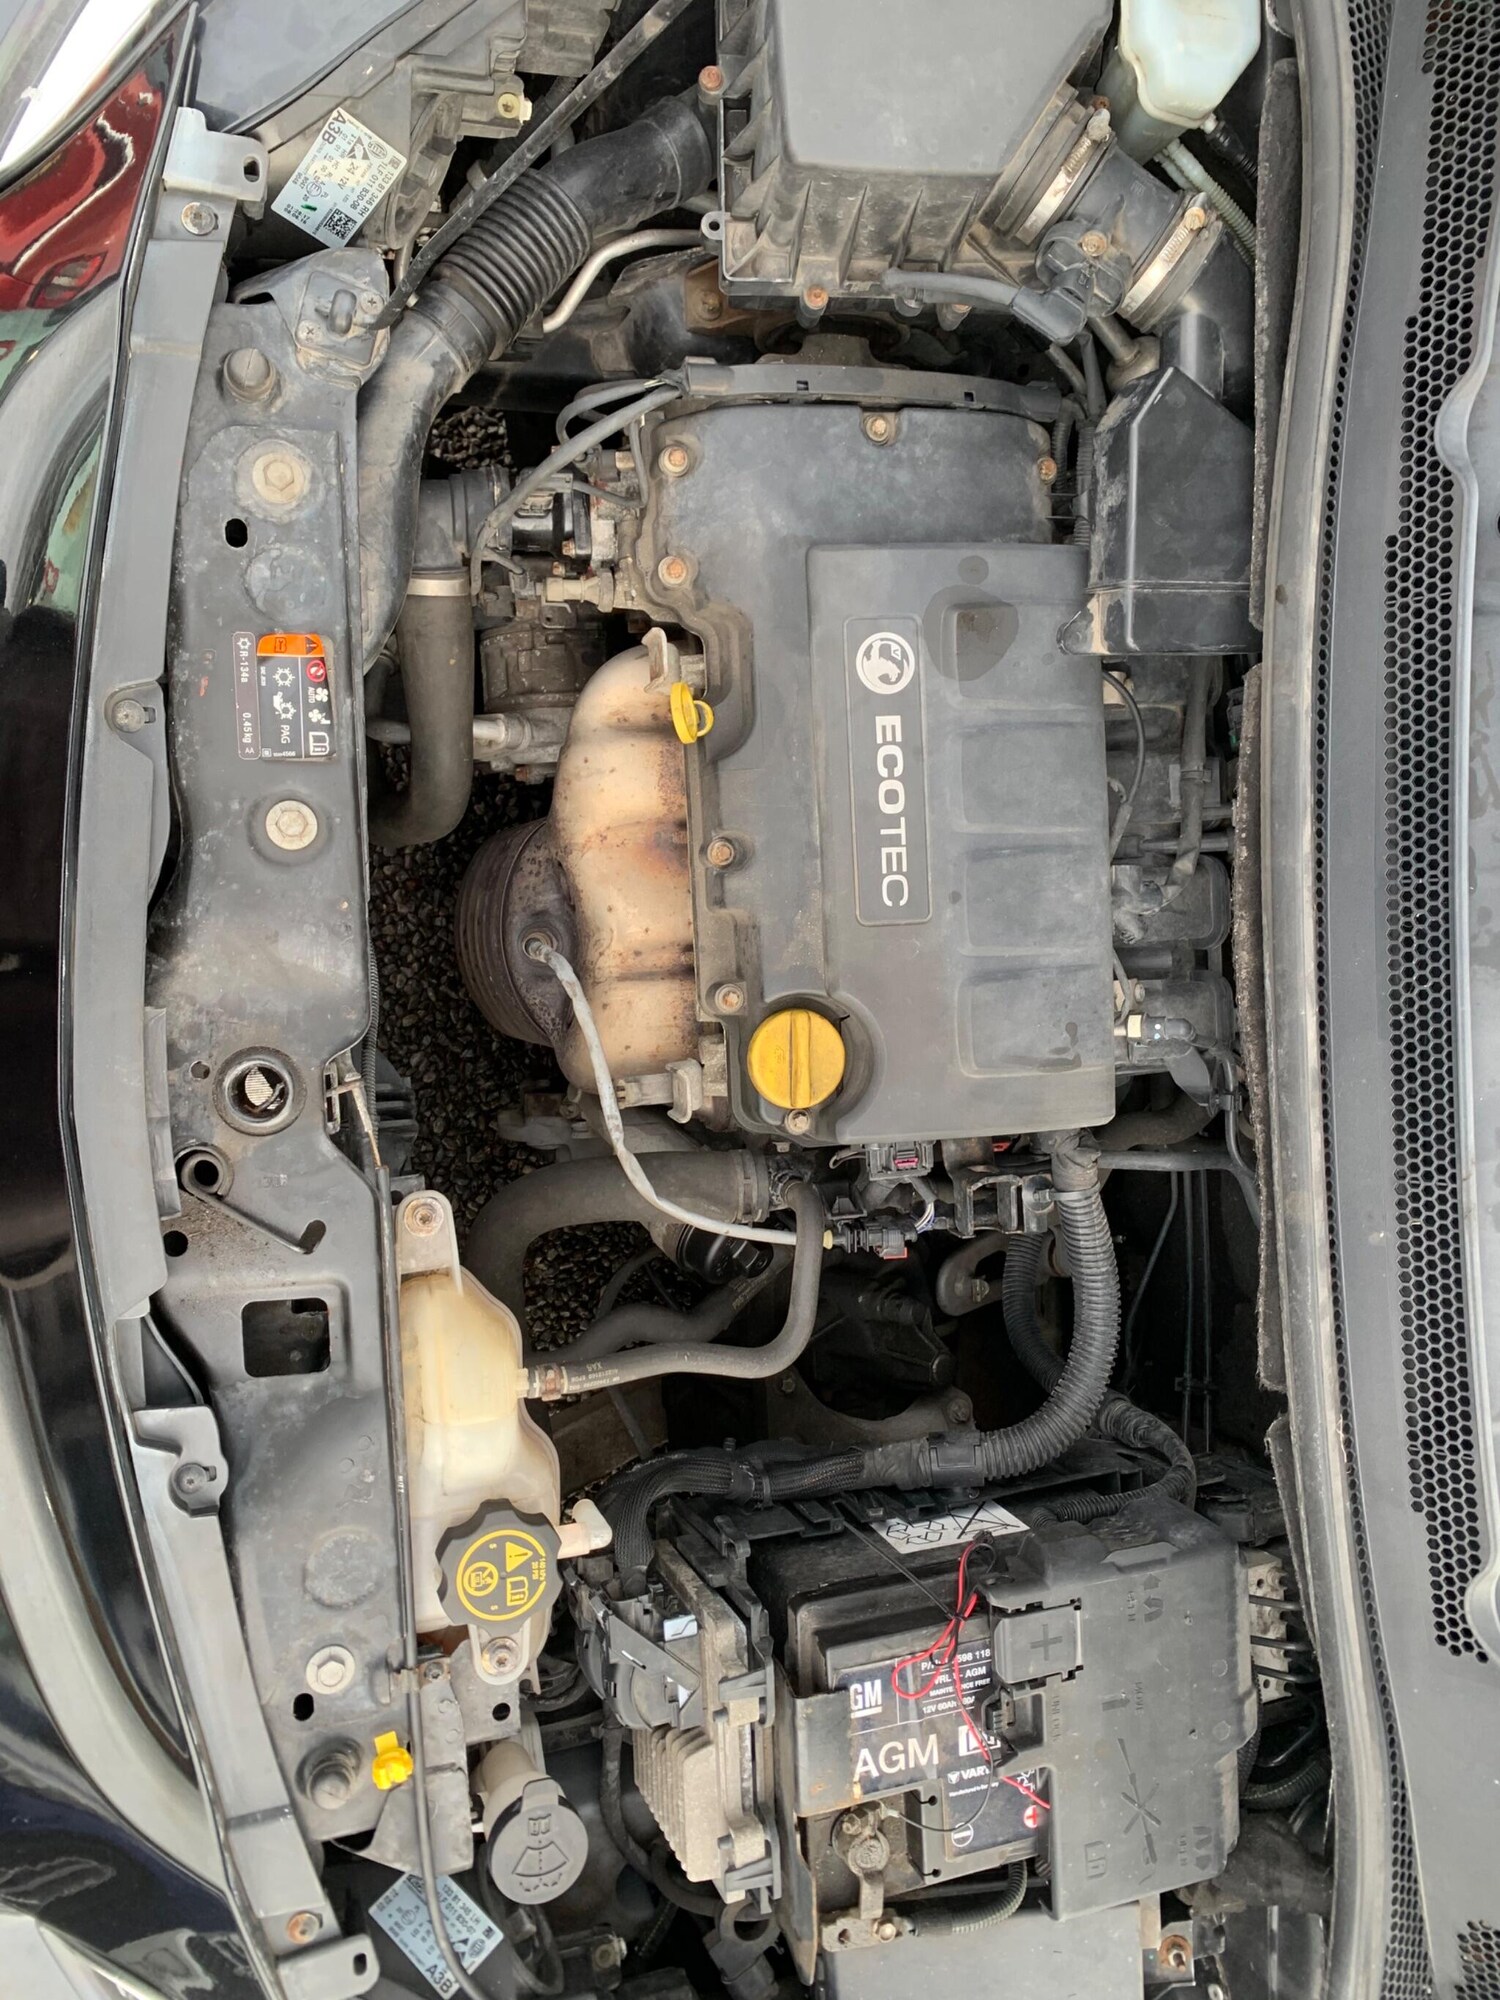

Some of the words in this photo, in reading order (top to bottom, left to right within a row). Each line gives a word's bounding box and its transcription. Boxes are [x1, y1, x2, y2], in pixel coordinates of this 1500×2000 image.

[322, 110, 346, 144] A3B
[337, 176, 348, 189] 12V
[357, 205, 369, 217] RH
[239, 651, 249, 683] R-134a
[242, 713, 252, 743] 0.45kg
[281, 724, 291, 744] PAG
[875, 715, 909, 907] ECOTEC
[975, 1650, 991, 1660] 118
[965, 1666, 986, 1677] AGM
[975, 1679, 991, 1688] FREE
[850, 1679, 882, 1710] GM
[923, 1703, 936, 1714] 12V
[853, 1734, 939, 1782] AGM
[425, 1964, 452, 1993] A3B
